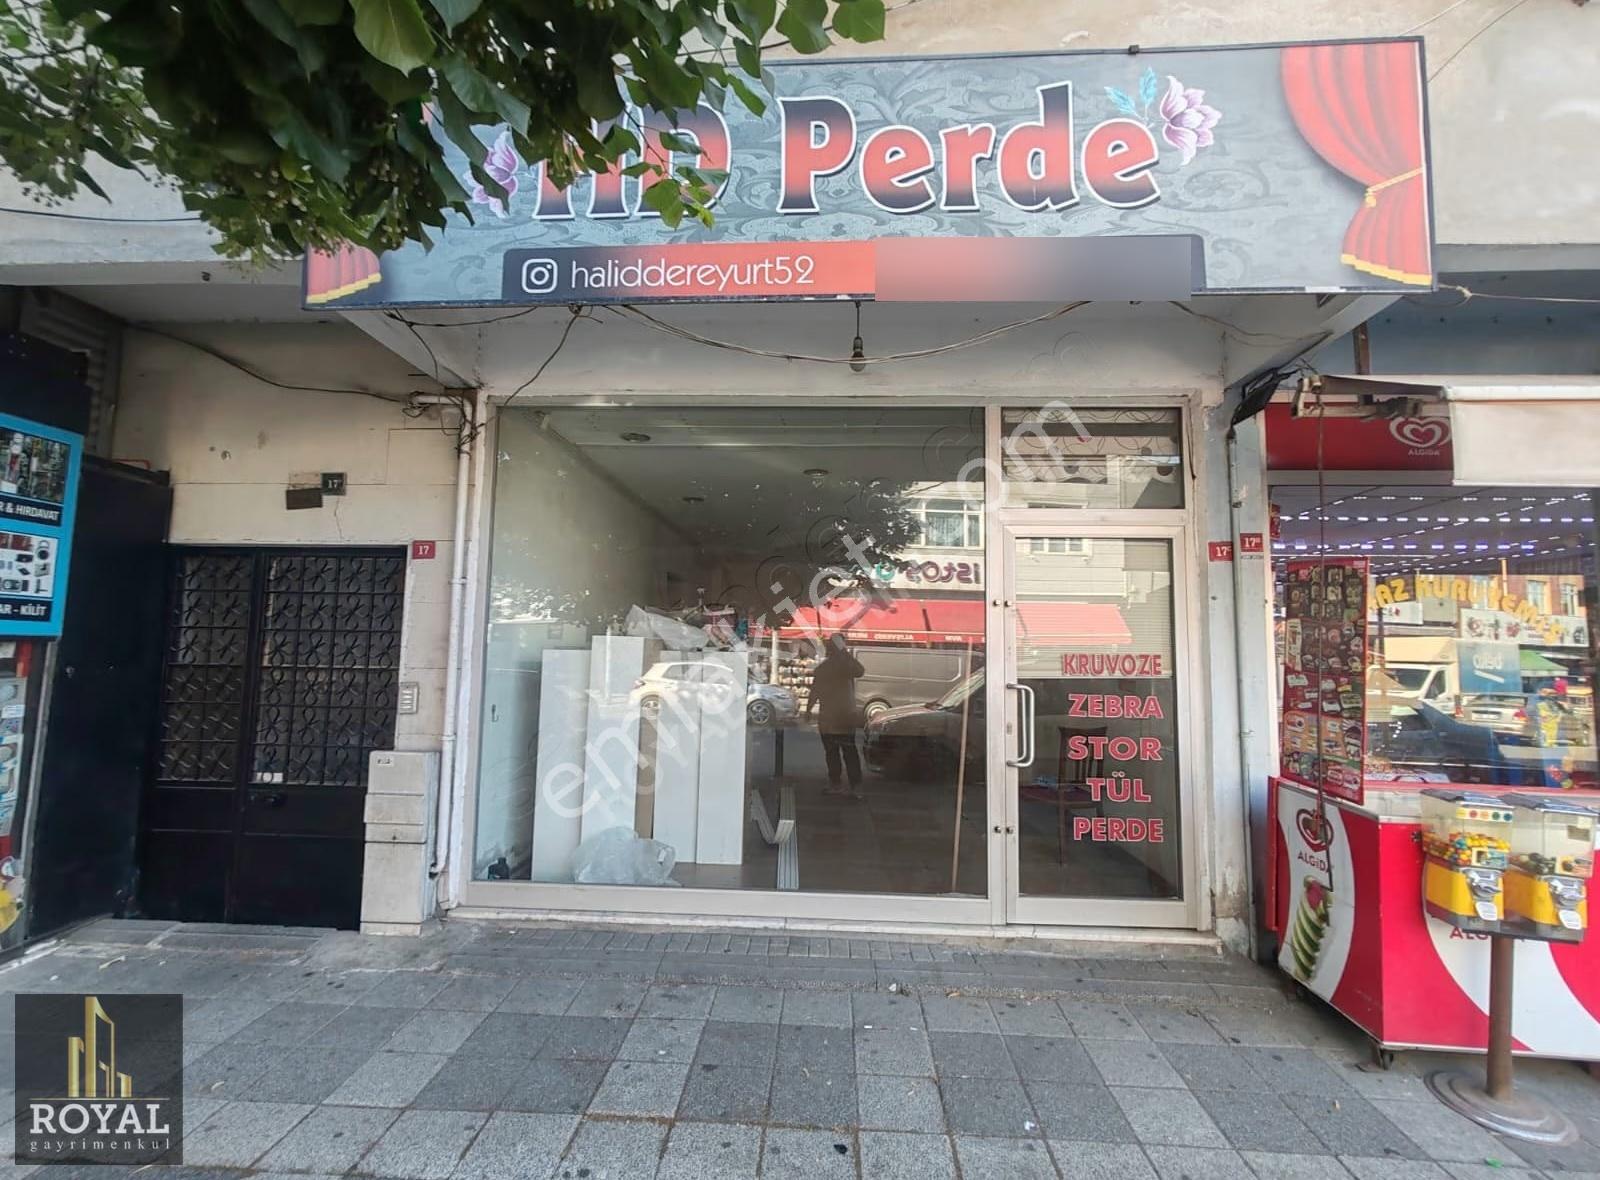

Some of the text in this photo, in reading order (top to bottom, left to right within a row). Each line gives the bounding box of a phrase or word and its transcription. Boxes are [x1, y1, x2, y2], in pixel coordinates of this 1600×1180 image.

[776, 81, 1161, 214] Perde
[571, 256, 814, 291] haliddereyurt52
[16, 504, 60, 520] HIRDAVAT
[418, 545, 430, 555] 17
[1061, 653, 1162, 677] KRUVOZE
[1067, 693, 1164, 719] ZEBRA
[1067, 735, 1162, 761] STOR
[1086, 771, 1151, 802] TÜL
[1073, 816, 1164, 843] PERDE
